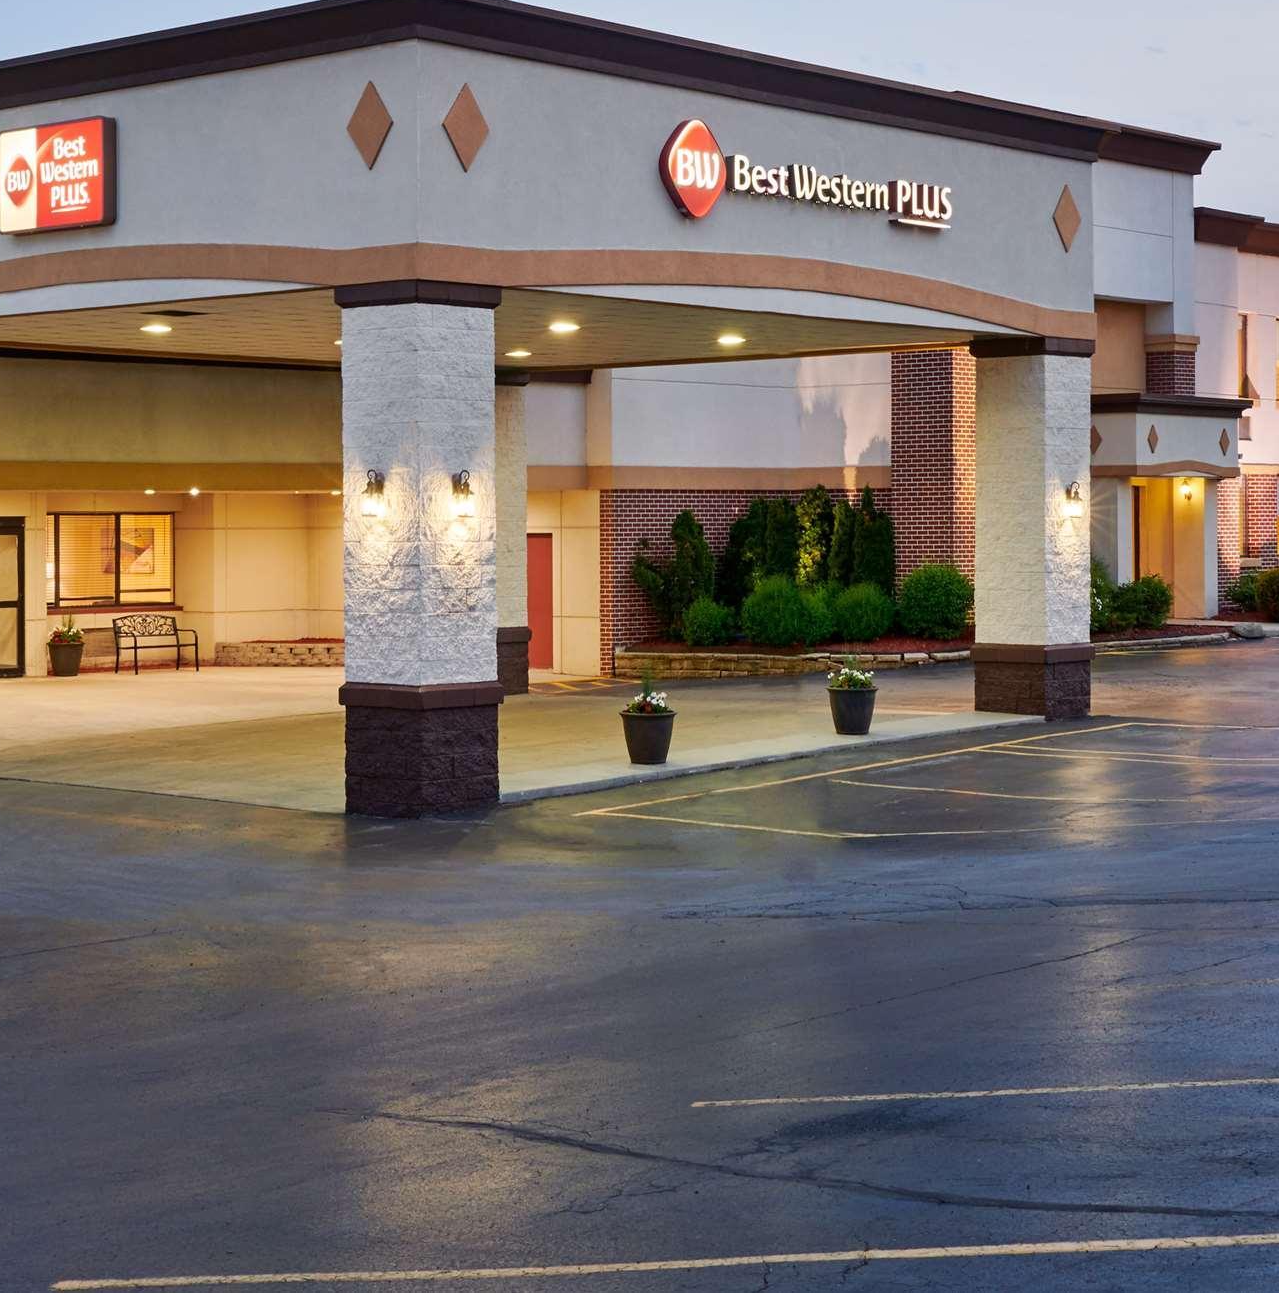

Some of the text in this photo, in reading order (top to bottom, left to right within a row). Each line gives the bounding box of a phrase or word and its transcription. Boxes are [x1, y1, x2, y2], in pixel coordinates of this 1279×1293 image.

[53, 136, 86, 159] Best
[7, 169, 31, 193] BW
[40, 159, 98, 184] Western
[676, 148, 720, 189] BW
[734, 154, 952, 220] Best Western PLUS
